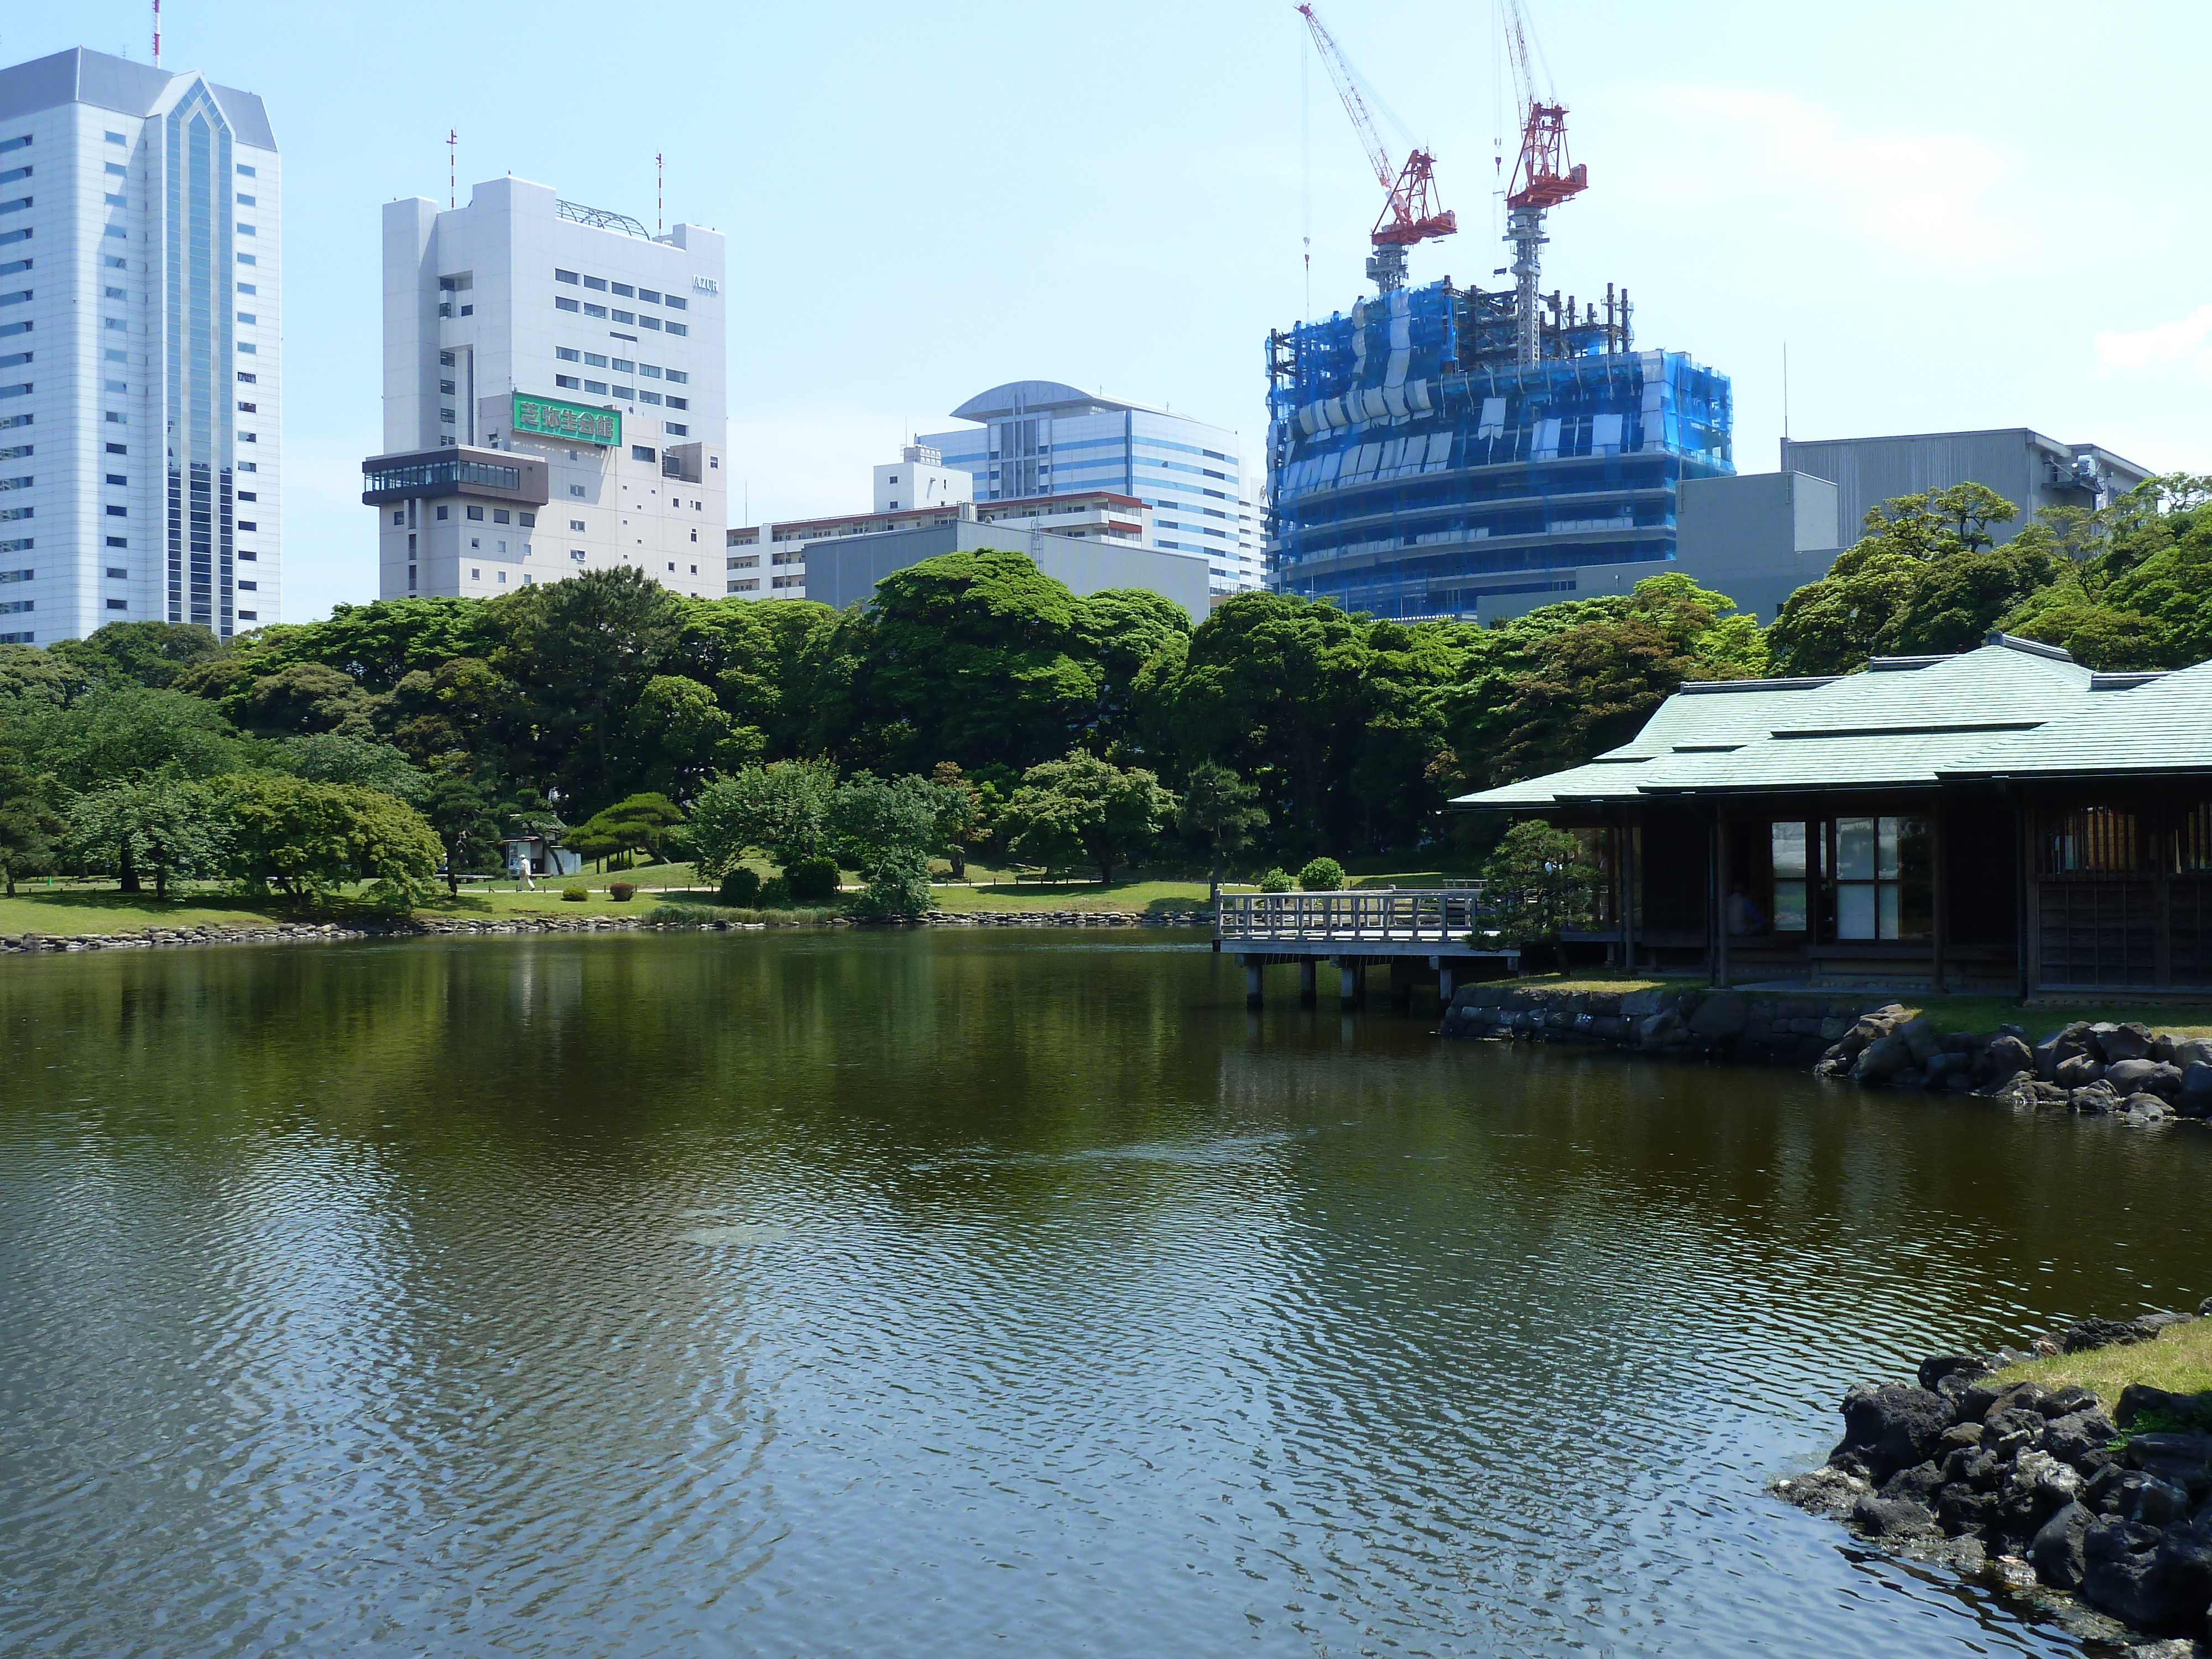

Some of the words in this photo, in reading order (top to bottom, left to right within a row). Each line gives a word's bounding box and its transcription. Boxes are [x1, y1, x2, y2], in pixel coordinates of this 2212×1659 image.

[692, 274, 718, 293] AZUR
[520, 401, 614, 439] 芝弥生会館
